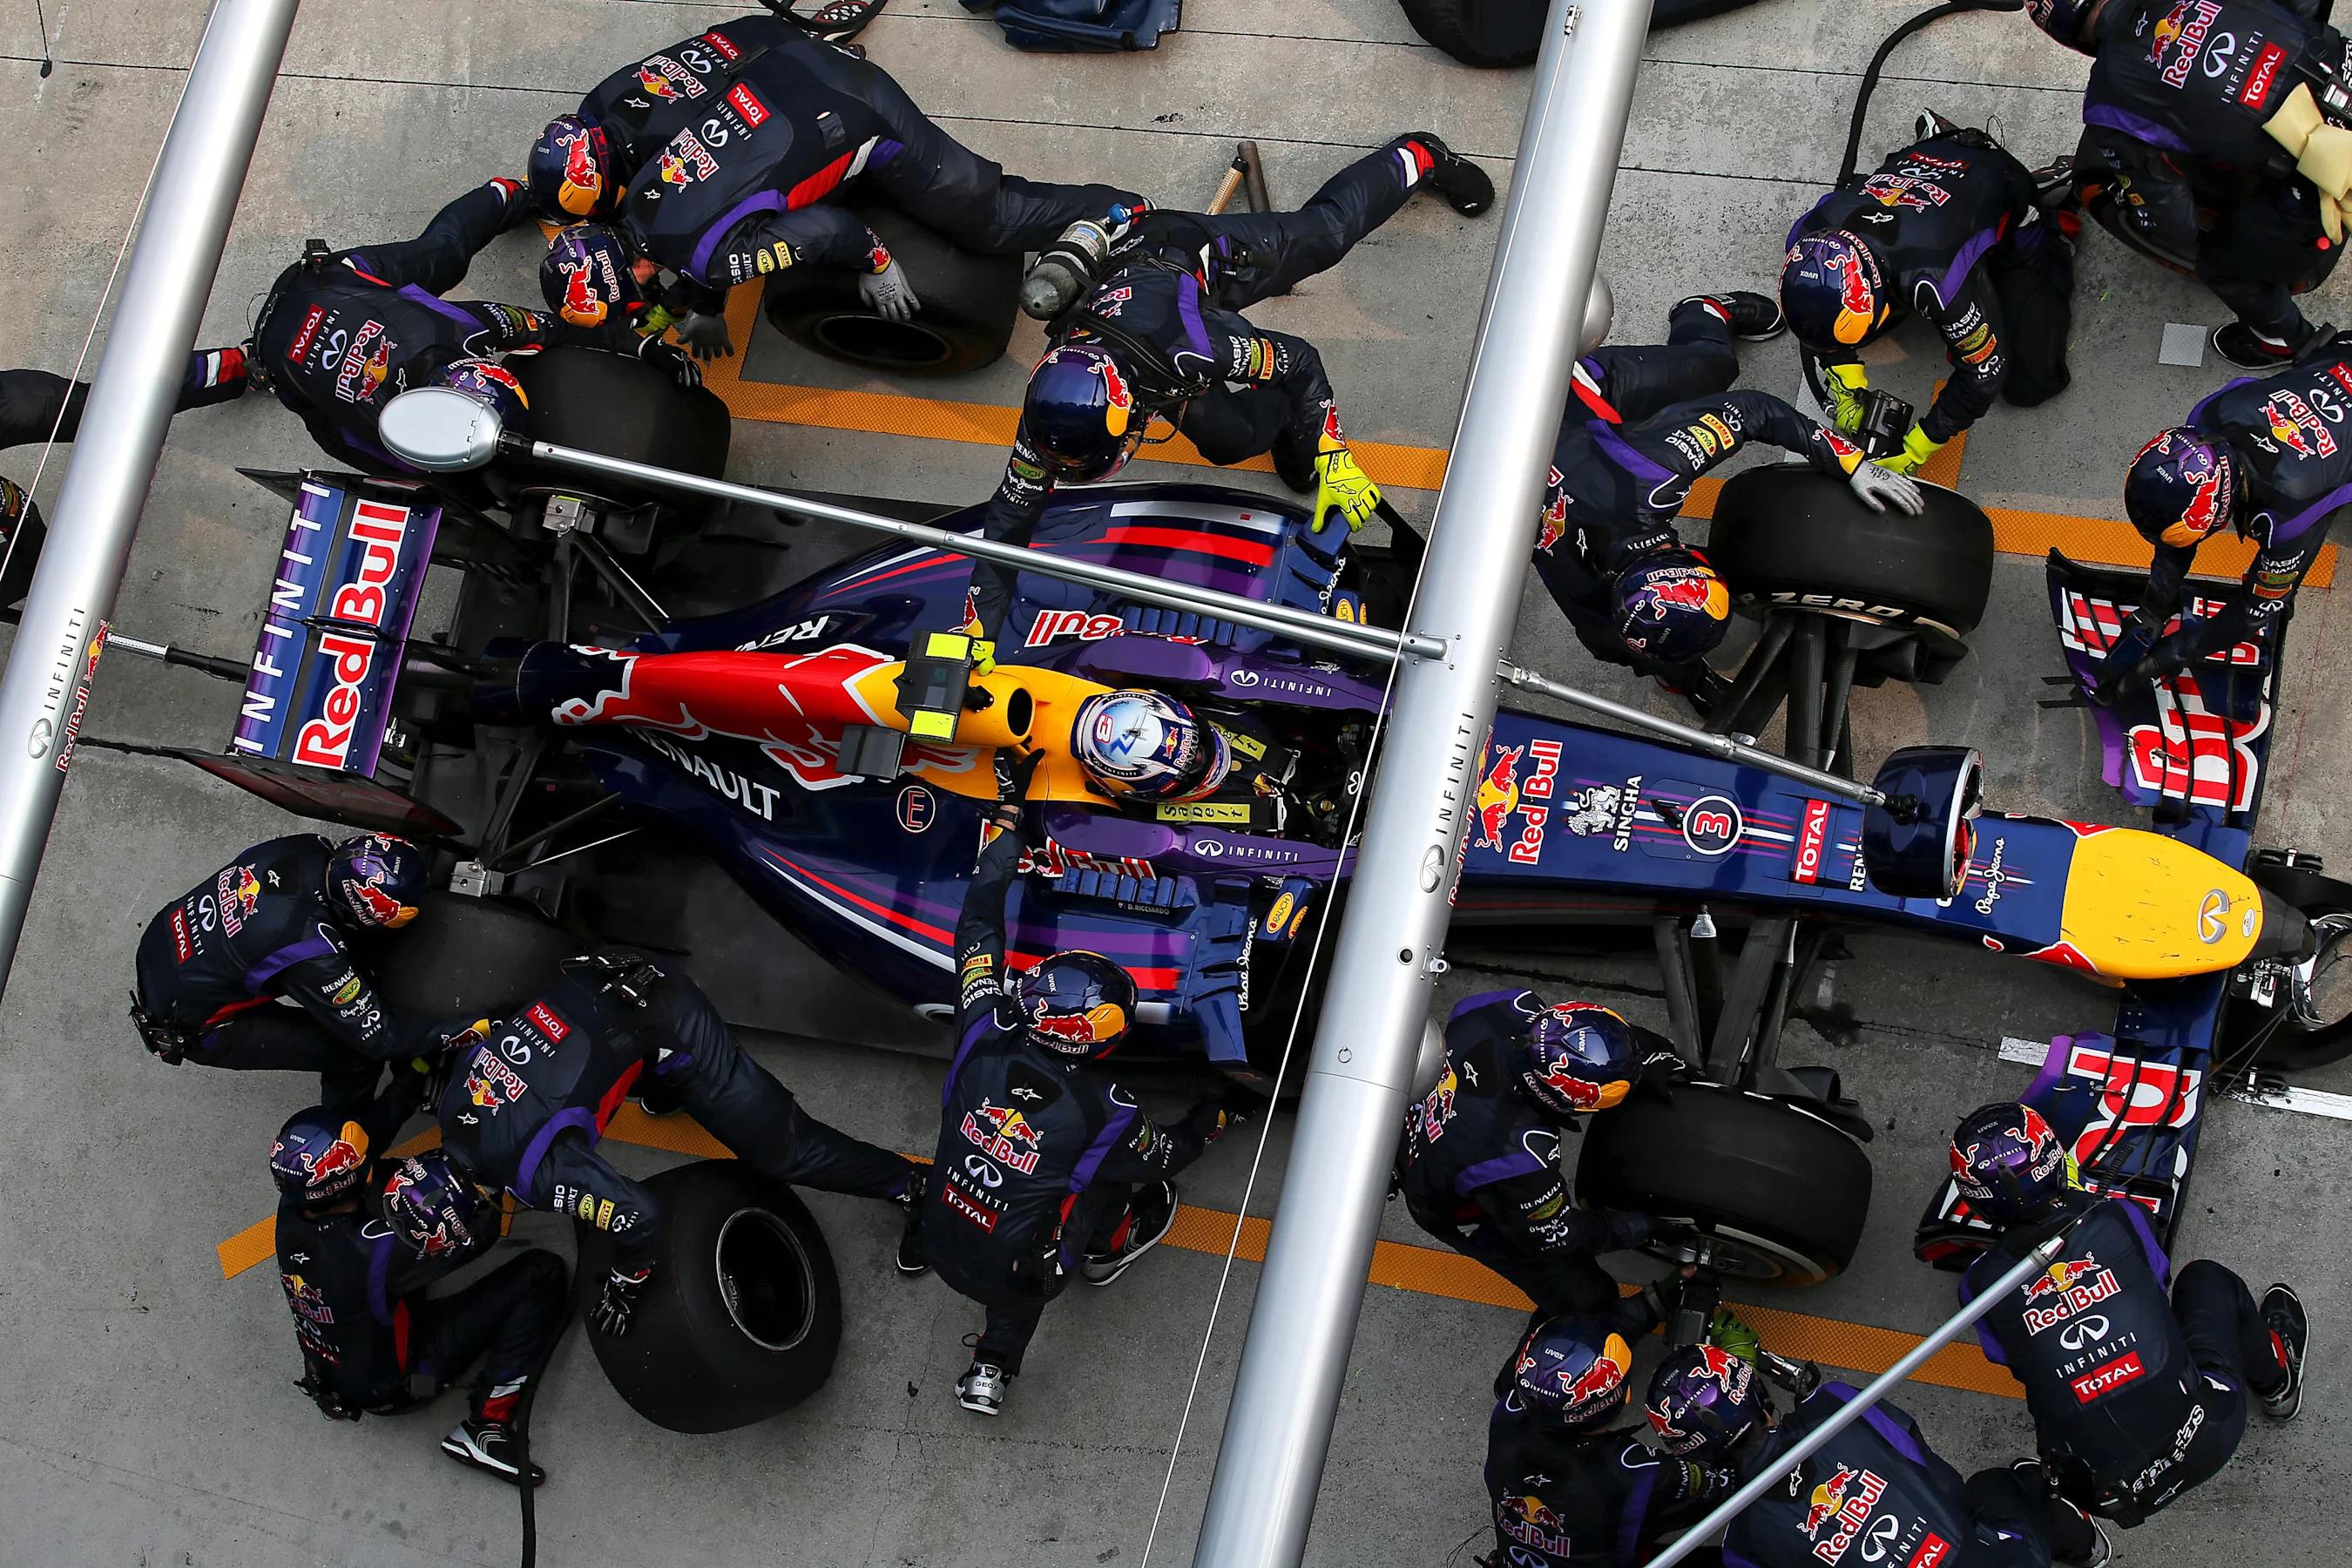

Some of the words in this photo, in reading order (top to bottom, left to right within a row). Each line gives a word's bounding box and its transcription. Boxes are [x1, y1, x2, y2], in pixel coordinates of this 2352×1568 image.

[711, 33, 739, 60] OTAL
[2220, 30, 2264, 103] INFINITI
[2244, 51, 2281, 103] TOTAL
[715, 100, 753, 141] INFINITI
[733, 87, 765, 127] TOTAL
[1800, 271, 1819, 280] uvex
[292, 310, 322, 358] TOTAL
[304, 309, 341, 376] INFINITI
[1228, 335, 1242, 377] CASIO
[1665, 436, 1701, 470] CASIO
[1672, 429, 1706, 463] RENAULT
[2155, 465, 2174, 483] uvex
[330, 498, 411, 633] Bull
[1319, 557, 1347, 605] Jeans
[233, 482, 331, 752] INFINITI
[1771, 591, 1906, 617] ZERO
[1024, 609, 1125, 647] Bull
[44, 608, 86, 712] INFINITI
[292, 633, 376, 771] Red
[1263, 677, 1333, 697] INFINITI
[1096, 714, 1114, 744] 3
[1173, 720, 1200, 781] RENAULT
[1523, 739, 1564, 800] Bull
[1436, 711, 1476, 835] INFINITI
[906, 790, 926, 828] E
[1612, 774, 1643, 853] SINGHA
[1693, 810, 1732, 840] 3
[1227, 846, 1301, 862] INFINITI
[1508, 804, 1550, 865] Red
[1794, 801, 1828, 881] TOTAL
[393, 856, 402, 875] uvex
[1983, 837, 2005, 883] Jeans
[1273, 896, 1291, 924] RAUCH
[1975, 882, 2001, 915] Pepe
[172, 909, 186, 960] TOTAL
[186, 896, 205, 956] INFINITI
[1236, 917, 1257, 970] Jeans
[341, 979, 360, 1000] RAUCH
[963, 986, 1004, 1009] CASIO
[1047, 973, 1057, 993] uvex
[361, 1023, 382, 1041] INFIN
[512, 1017, 557, 1058] INFINITI
[534, 1004, 564, 1040] TOTAL
[1578, 1031, 1586, 1053] uvex
[289, 1133, 307, 1145] uvex
[1977, 1121, 1998, 1133] uvex
[946, 1166, 1010, 1212] INFINITI
[947, 1186, 991, 1228] TOTAL
[1544, 1348, 1565, 1360] uvex
[2055, 1331, 2139, 1379] INFINITI
[974, 1381, 999, 1391] GEOX
[2075, 1362, 2140, 1397] TOTAL
